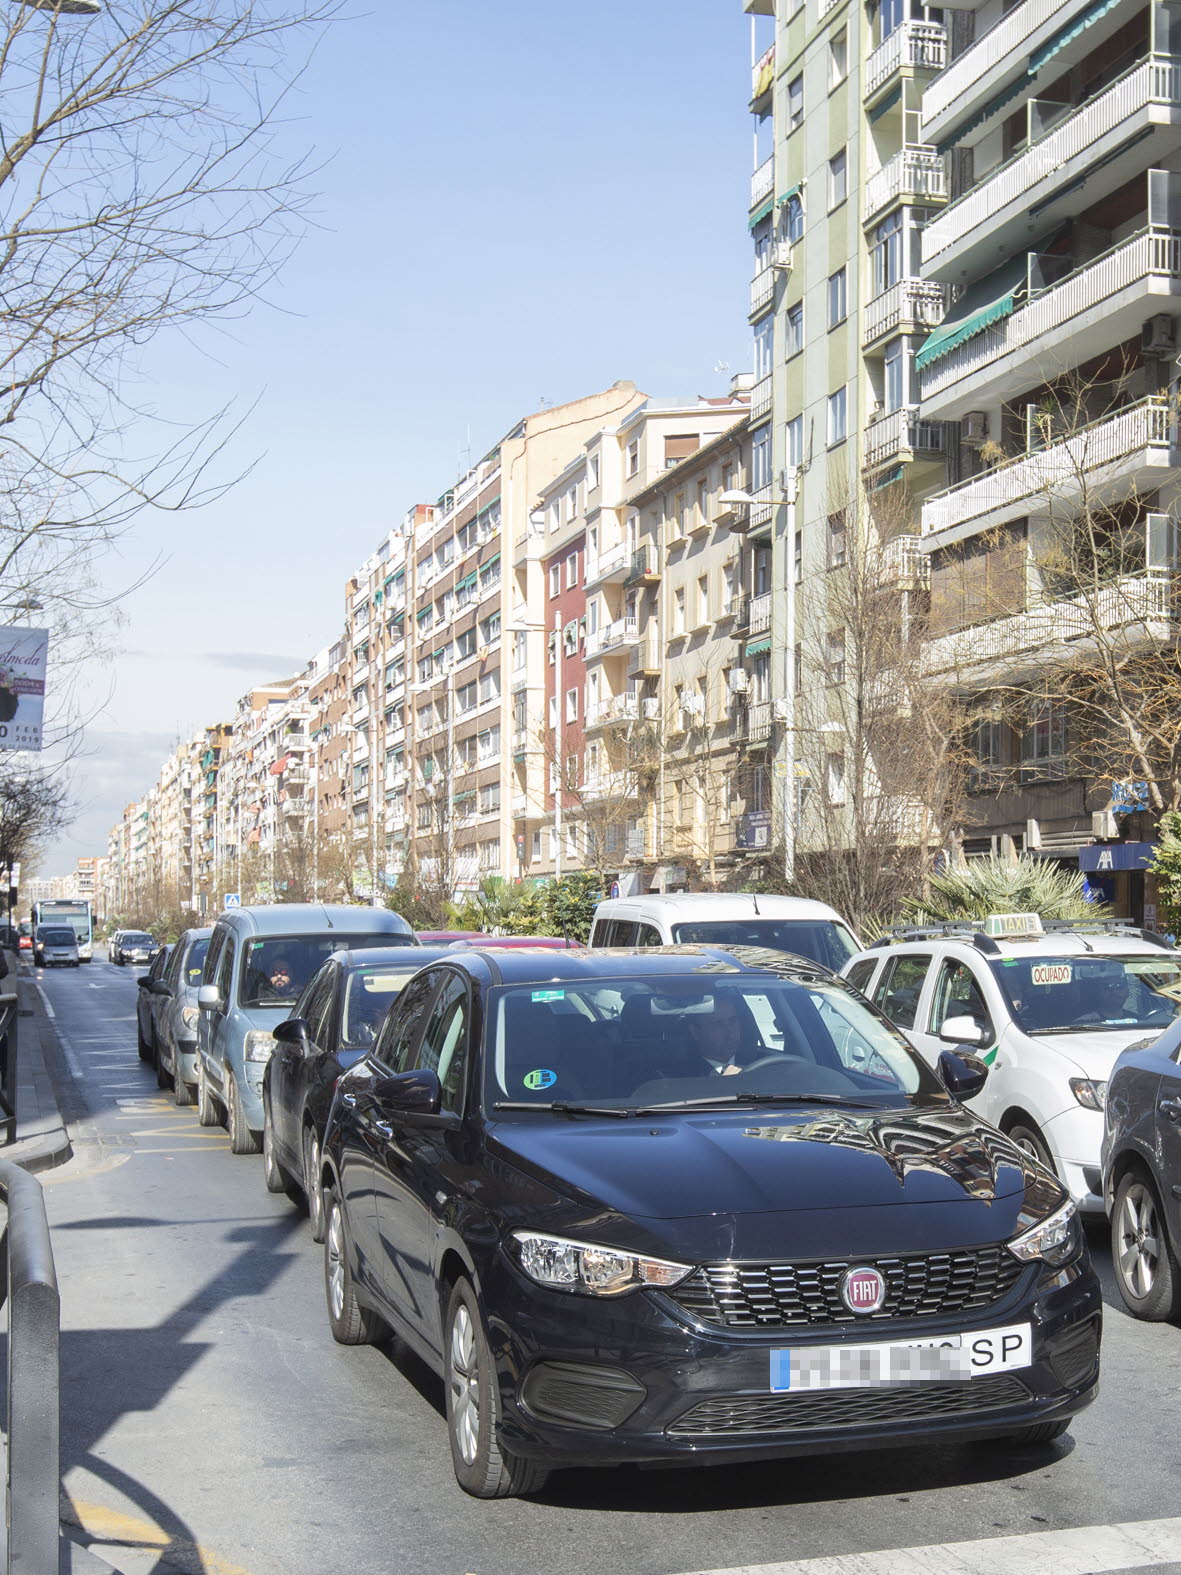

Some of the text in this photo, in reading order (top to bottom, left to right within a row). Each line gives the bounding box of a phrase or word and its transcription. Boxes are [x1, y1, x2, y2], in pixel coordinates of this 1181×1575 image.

[1003, 916, 1026, 930] TAXI
[1034, 967, 1069, 982] OCUPADO
[853, 1280, 877, 1301] FIAT
[971, 1334, 1023, 1366] SP
